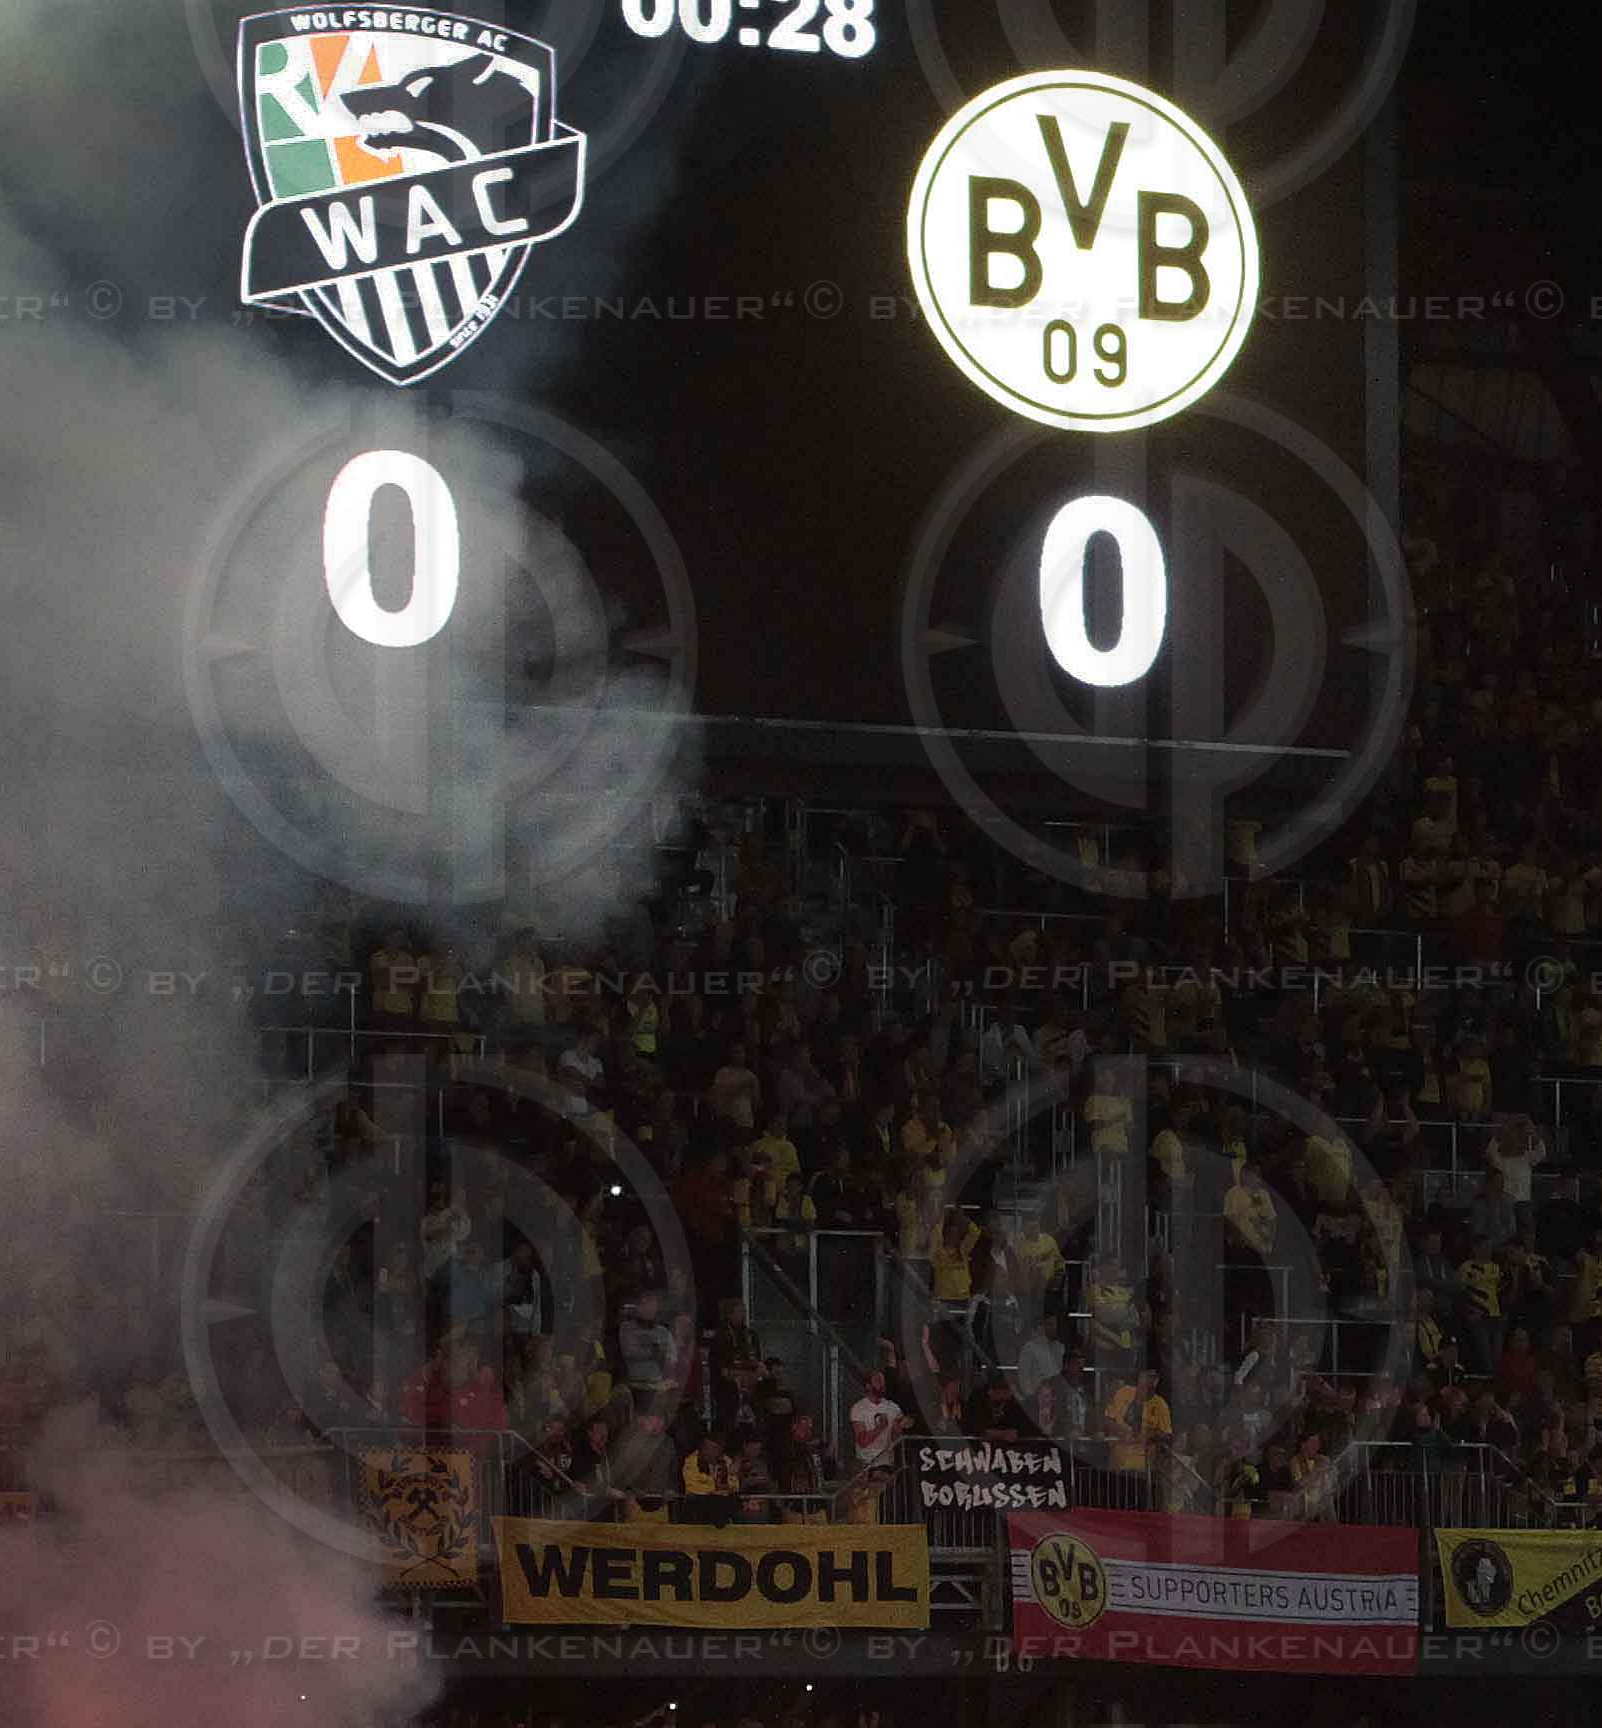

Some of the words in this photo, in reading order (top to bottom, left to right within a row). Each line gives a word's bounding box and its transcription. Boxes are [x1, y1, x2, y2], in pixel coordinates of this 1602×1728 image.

[290, 12, 470, 42] WOLFSBERGER
[477, 30, 510, 54] AC
[300, 167, 528, 271] WAC
[968, 114, 1210, 321] BVB
[1043, 320, 1128, 388] 09
[322, 449, 460, 647] 0
[1039, 494, 1167, 687] 0
[919, 1443, 1062, 1475] SCHWABEN
[922, 1479, 1067, 1511] BORUSSEN
[515, 1543, 918, 1604] WERDOHL
[1036, 1540, 1099, 1602] BVB
[1131, 1574, 1289, 1611] SUPPORTERS
[1298, 1581, 1399, 1612] AUSTRIA
